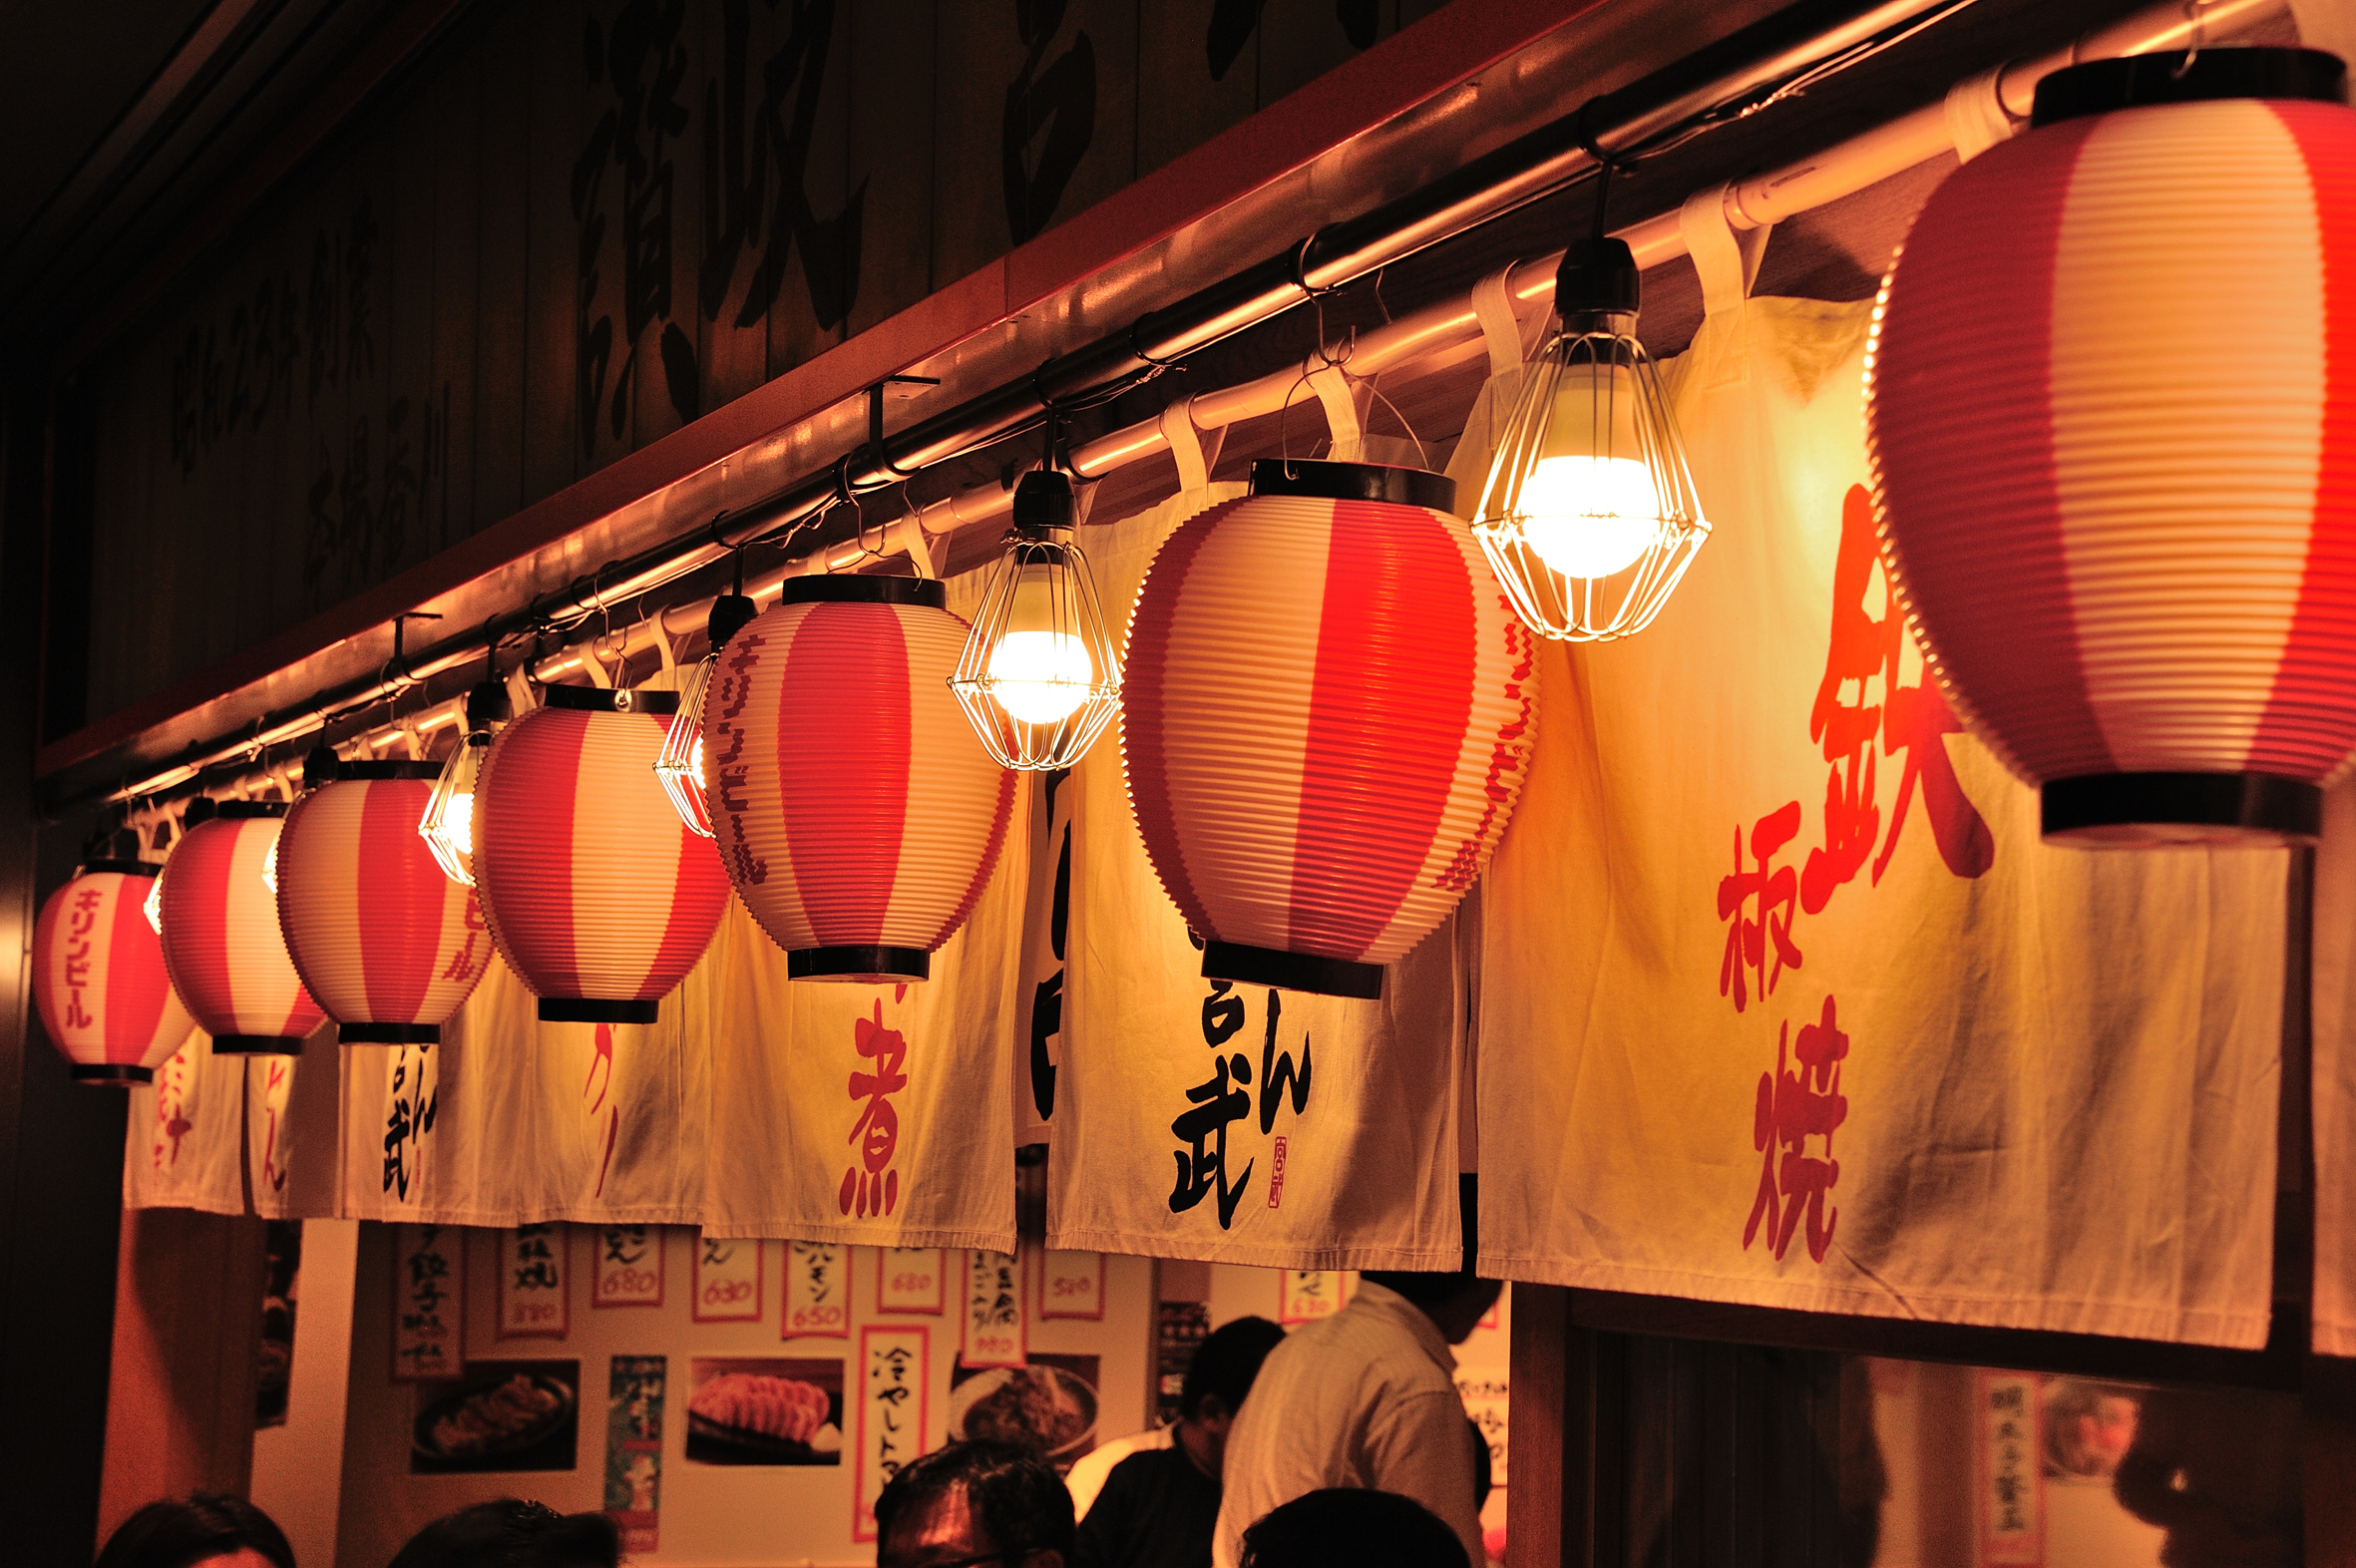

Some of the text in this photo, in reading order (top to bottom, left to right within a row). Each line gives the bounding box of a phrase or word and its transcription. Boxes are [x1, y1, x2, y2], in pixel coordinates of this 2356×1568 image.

[716, 634, 768, 886] キリンビール
[62, 890, 103, 1029] キリンビール
[602, 1267, 657, 1295] 680
[702, 1278, 753, 1306] 630
[793, 1305, 841, 1327] 650
